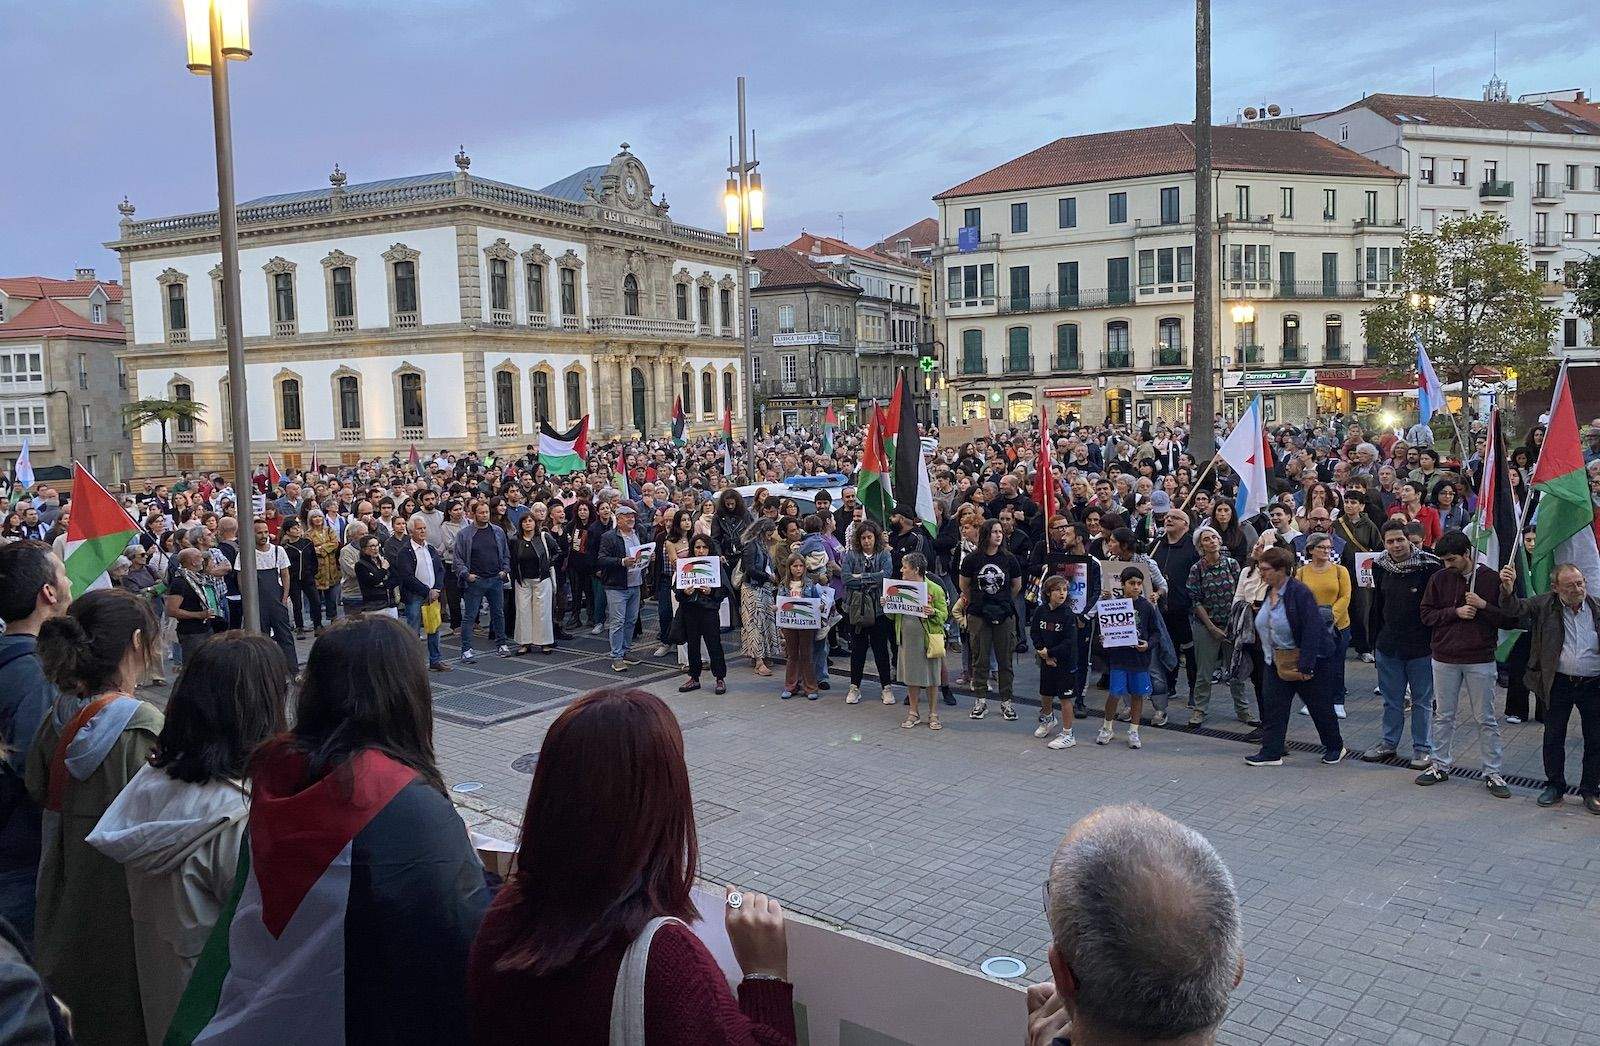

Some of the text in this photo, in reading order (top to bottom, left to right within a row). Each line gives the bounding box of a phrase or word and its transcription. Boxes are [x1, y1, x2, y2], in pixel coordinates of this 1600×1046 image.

[604, 210, 621, 223] CASA
[886, 602, 897, 610] CON
[1099, 612, 1134, 624] STOP
